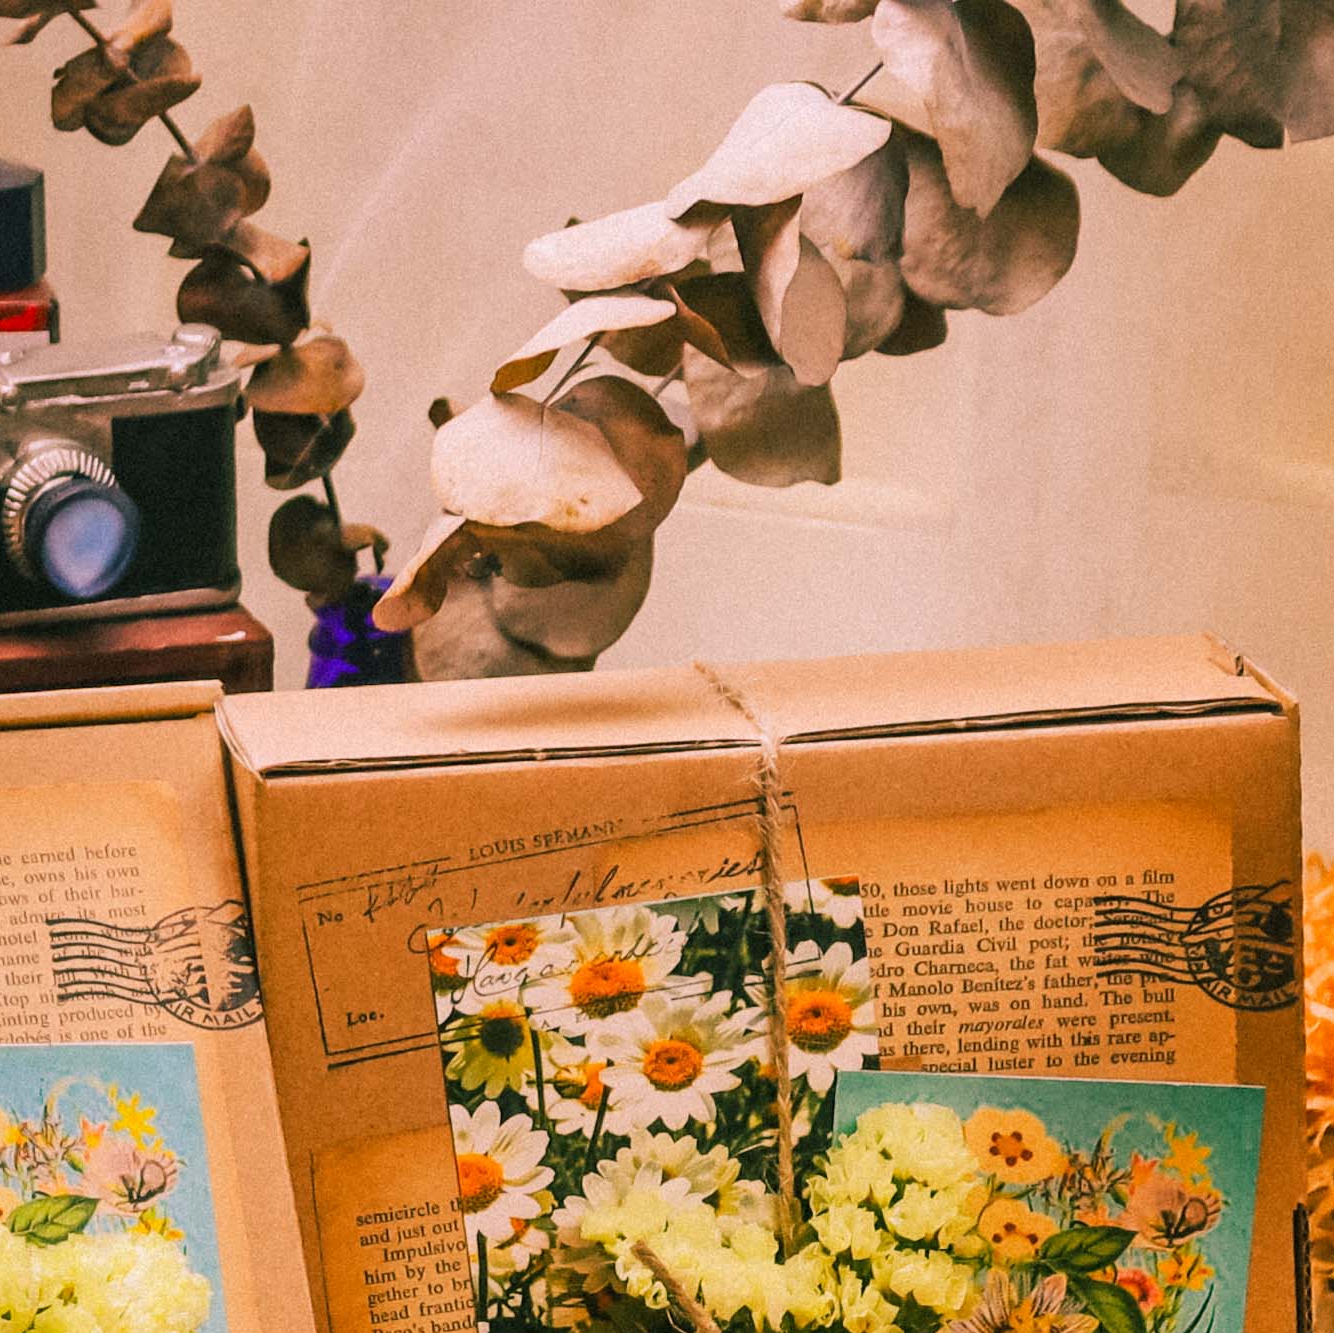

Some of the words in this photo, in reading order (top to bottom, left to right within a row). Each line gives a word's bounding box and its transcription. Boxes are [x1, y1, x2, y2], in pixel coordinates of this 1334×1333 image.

[21, 848, 75, 864] earned
[85, 843, 137, 860] before
[468, 838, 526, 861] LOUIS
[894, 883, 937, 897] those
[944, 879, 988, 898] lights
[996, 877, 1035, 890] went
[1044, 874, 1089, 889] down
[1143, 870, 1174, 885] film
[317, 910, 344, 926] No
[902, 900, 953, 917] movie
[966, 899, 1013, 913] house
[883, 922, 920, 937] Don
[929, 919, 988, 935] Rafael,
[895, 939, 964, 957] Guardia
[977, 937, 1017, 951] Civil
[914, 958, 999, 977] Charneca,
[889, 981, 954, 998] Manolo
[1100, 991, 1131, 1006] The
[1143, 989, 1175, 1003] bull
[59, 1005, 134, 1023] produced
[907, 1020, 946, 1035] their
[959, 1016, 1044, 1034] mayorales
[1110, 1013, 1175, 1029] present.
[903, 1041, 950, 1056] there,
[958, 1038, 1019, 1054] lending
[1027, 1034, 1062, 1049] with
[988, 1056, 1034, 1071] luster
[1111, 1049, 1176, 1064] evening
[356, 1202, 440, 1226] semicircle
[383, 1240, 466, 1262] Impulsivo
[368, 1286, 418, 1308] gether
